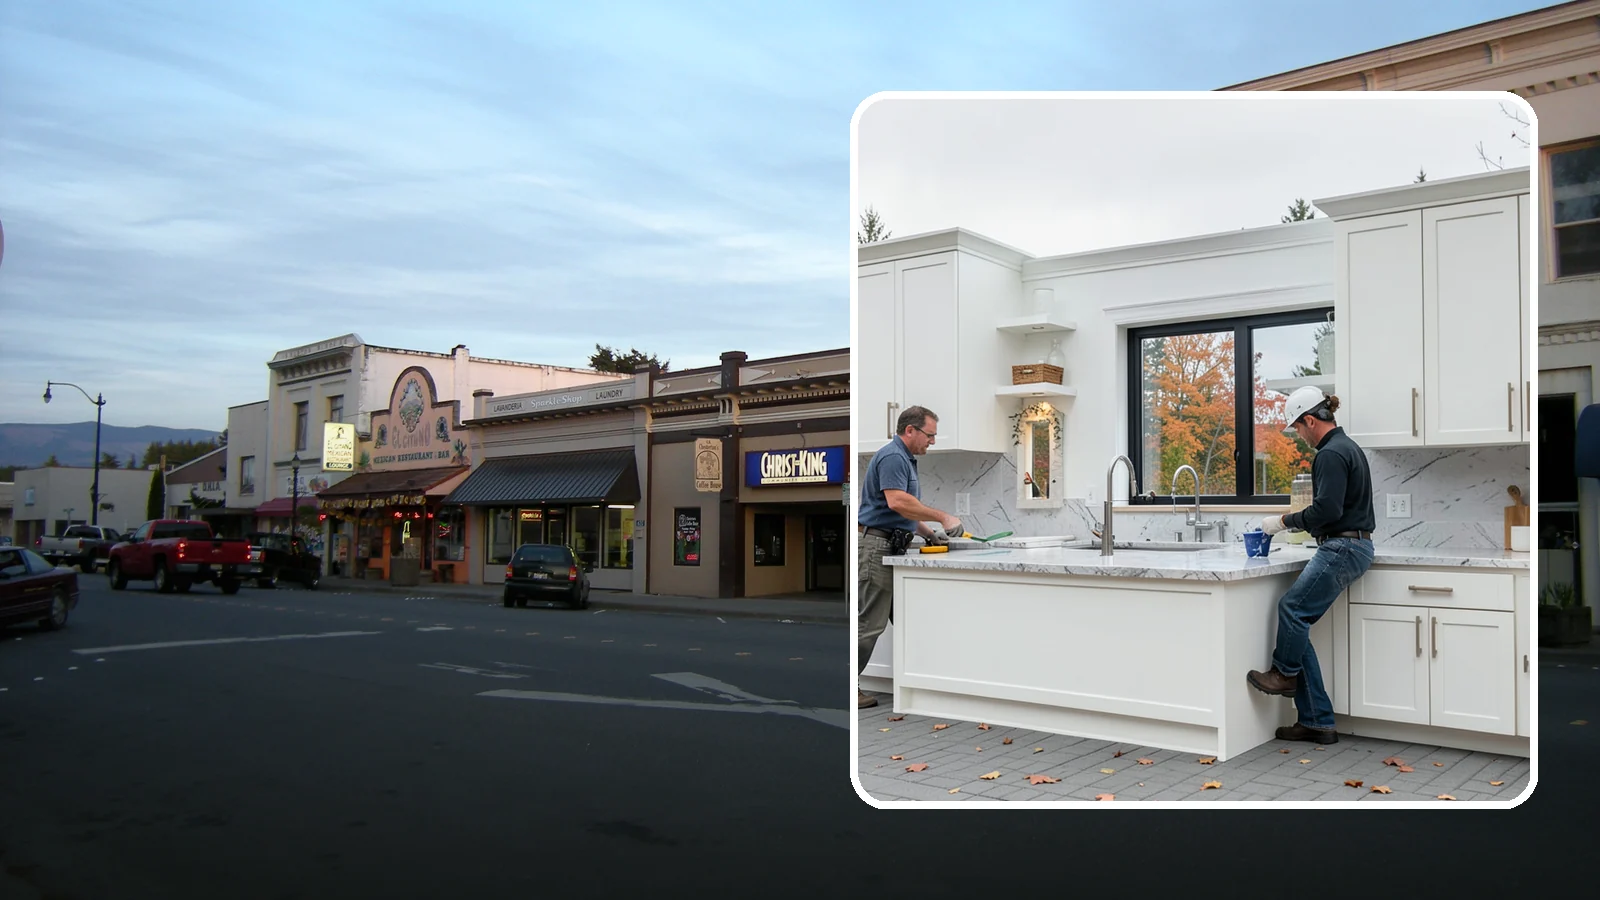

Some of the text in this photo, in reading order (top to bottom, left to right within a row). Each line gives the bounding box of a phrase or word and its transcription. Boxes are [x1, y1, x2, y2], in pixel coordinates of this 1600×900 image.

[530, 394, 583, 409] Sparkle Shop
[595, 389, 624, 400] LAUNDRY
[493, 402, 523, 413] LAVANDERIA
[374, 455, 396, 464] MEXICAN
[397, 451, 434, 462] RESTAURANT
[438, 450, 450, 459] BAR
[761, 450, 827, 478] CHRIST KING
